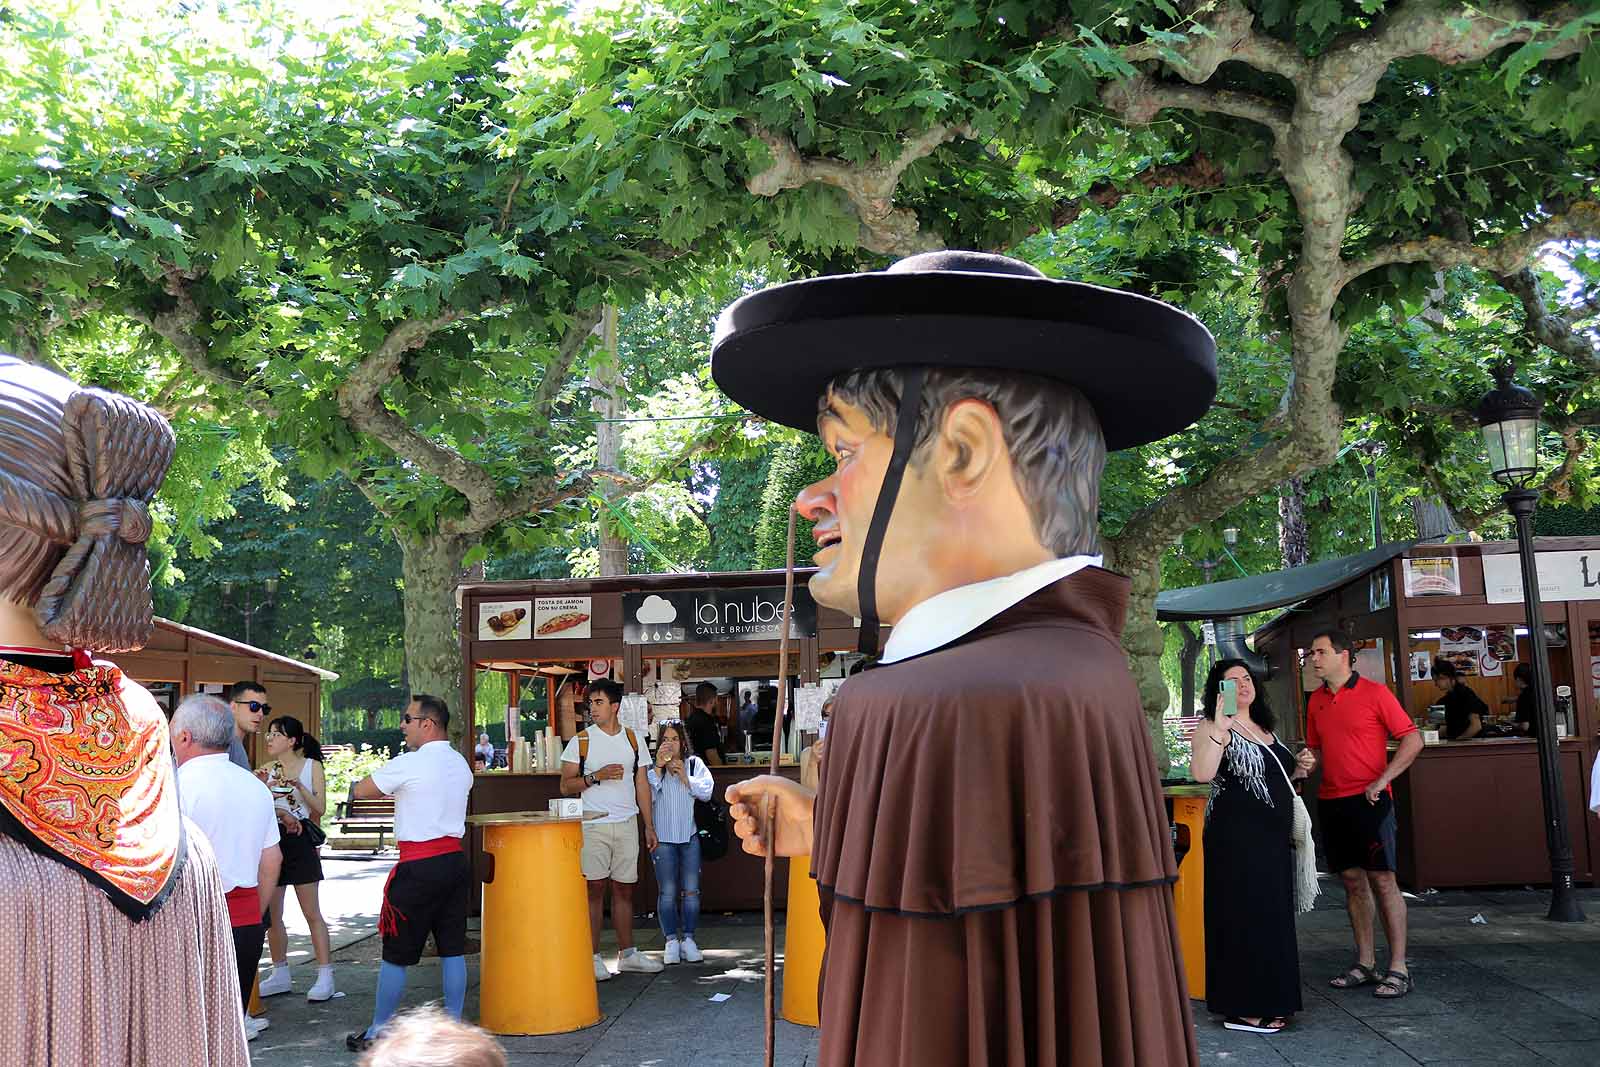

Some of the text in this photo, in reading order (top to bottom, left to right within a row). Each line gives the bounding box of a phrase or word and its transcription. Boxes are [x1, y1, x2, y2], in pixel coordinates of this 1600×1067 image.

[1579, 555, 1600, 588] L
[695, 595, 795, 625] la nube
[695, 626, 725, 635] CALLE
[729, 624, 781, 634] BRIVIESCA
